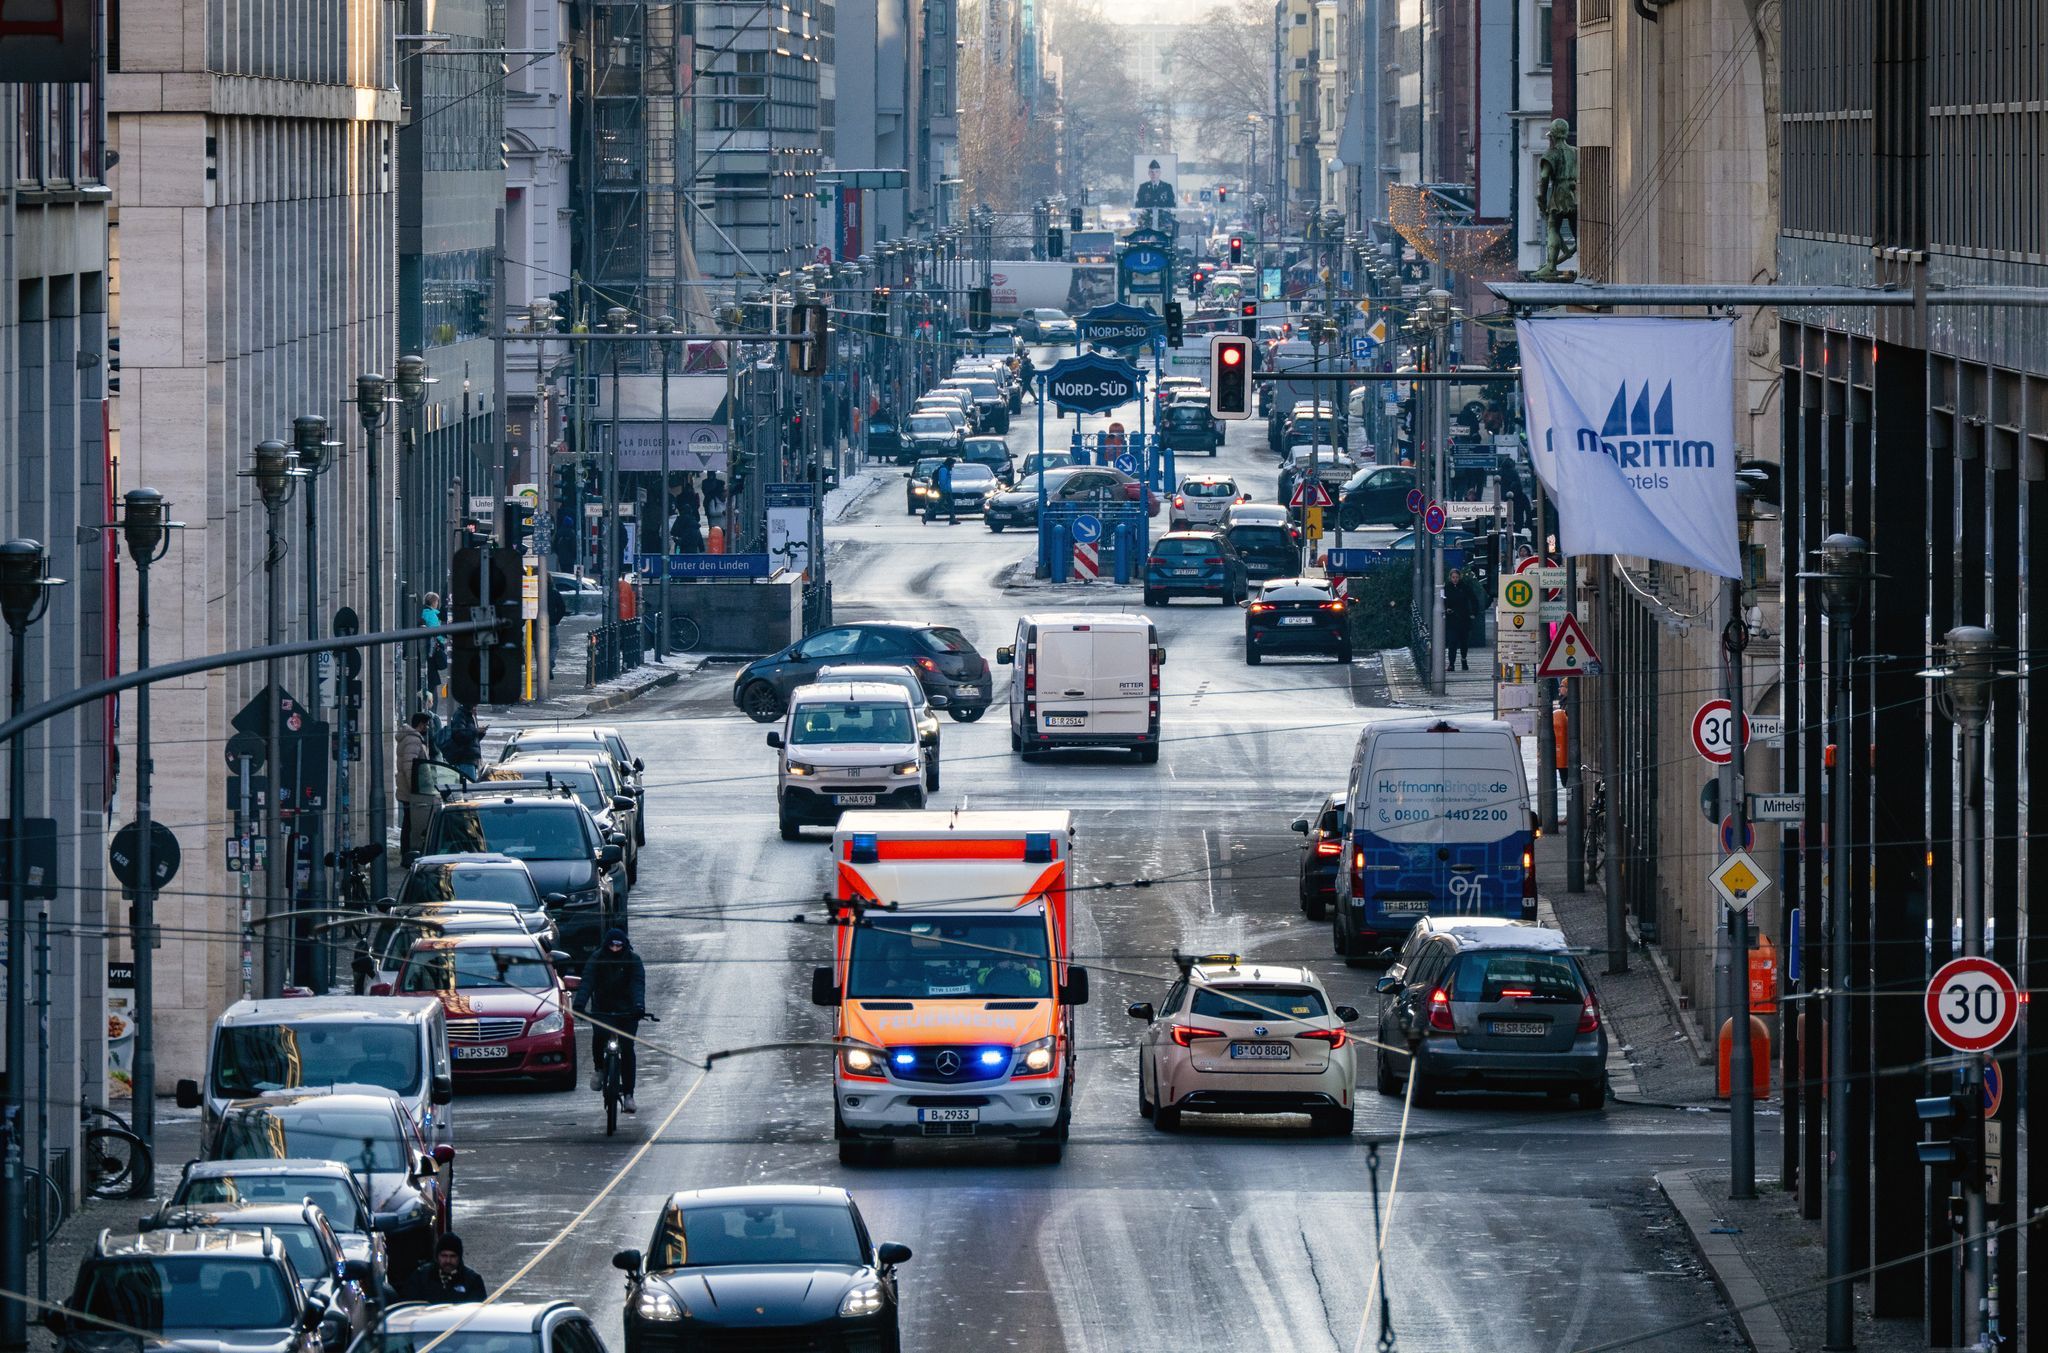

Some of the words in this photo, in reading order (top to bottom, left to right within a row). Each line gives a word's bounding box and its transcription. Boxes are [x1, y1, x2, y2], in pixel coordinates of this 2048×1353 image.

[1140, 252, 1150, 265] U
[1089, 325, 1146, 338] NORD-SÜD
[1055, 380, 1128, 396] NORD-SÜD
[1627, 473, 1669, 489] otels
[1452, 505, 1471, 513] Unter
[1472, 505, 1484, 513] den
[670, 560, 696, 570] Unter
[699, 560, 716, 570] den
[719, 560, 750, 570] Linden
[1332, 552, 1344, 567] U
[1512, 586, 1526, 601] H
[1394, 809, 1430, 821] 0800
[1444, 809, 1470, 821] 440
[1472, 809, 1489, 821] 22
[1491, 809, 1508, 821] 00
[1946, 984, 1998, 1024] 30
[878, 1008, 1018, 1031] FEUERWEHR
[484, 1047, 507, 1057] 5439
[944, 1110, 970, 1120] 2933
